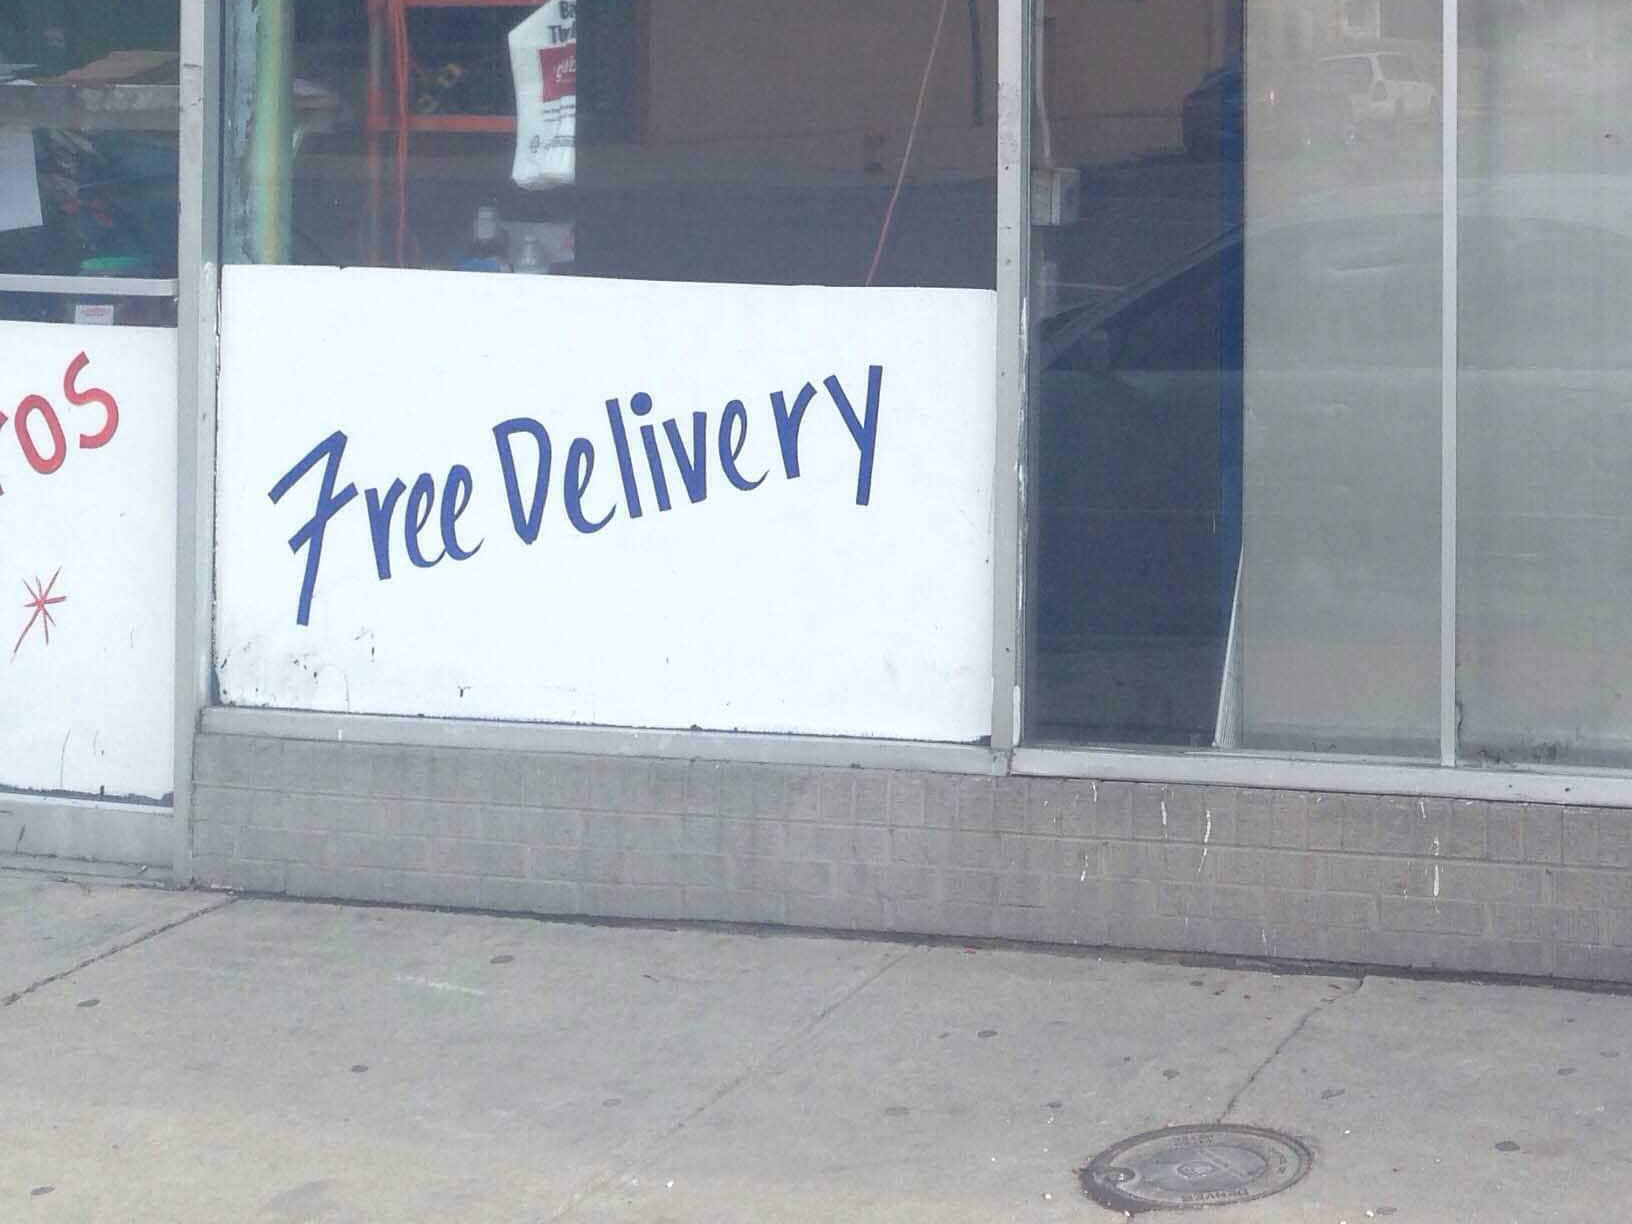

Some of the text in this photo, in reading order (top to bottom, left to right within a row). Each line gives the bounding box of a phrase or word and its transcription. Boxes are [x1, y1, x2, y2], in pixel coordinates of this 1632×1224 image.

[0, 350, 120, 496] OS
[267, 364, 884, 626] Free Delivery
